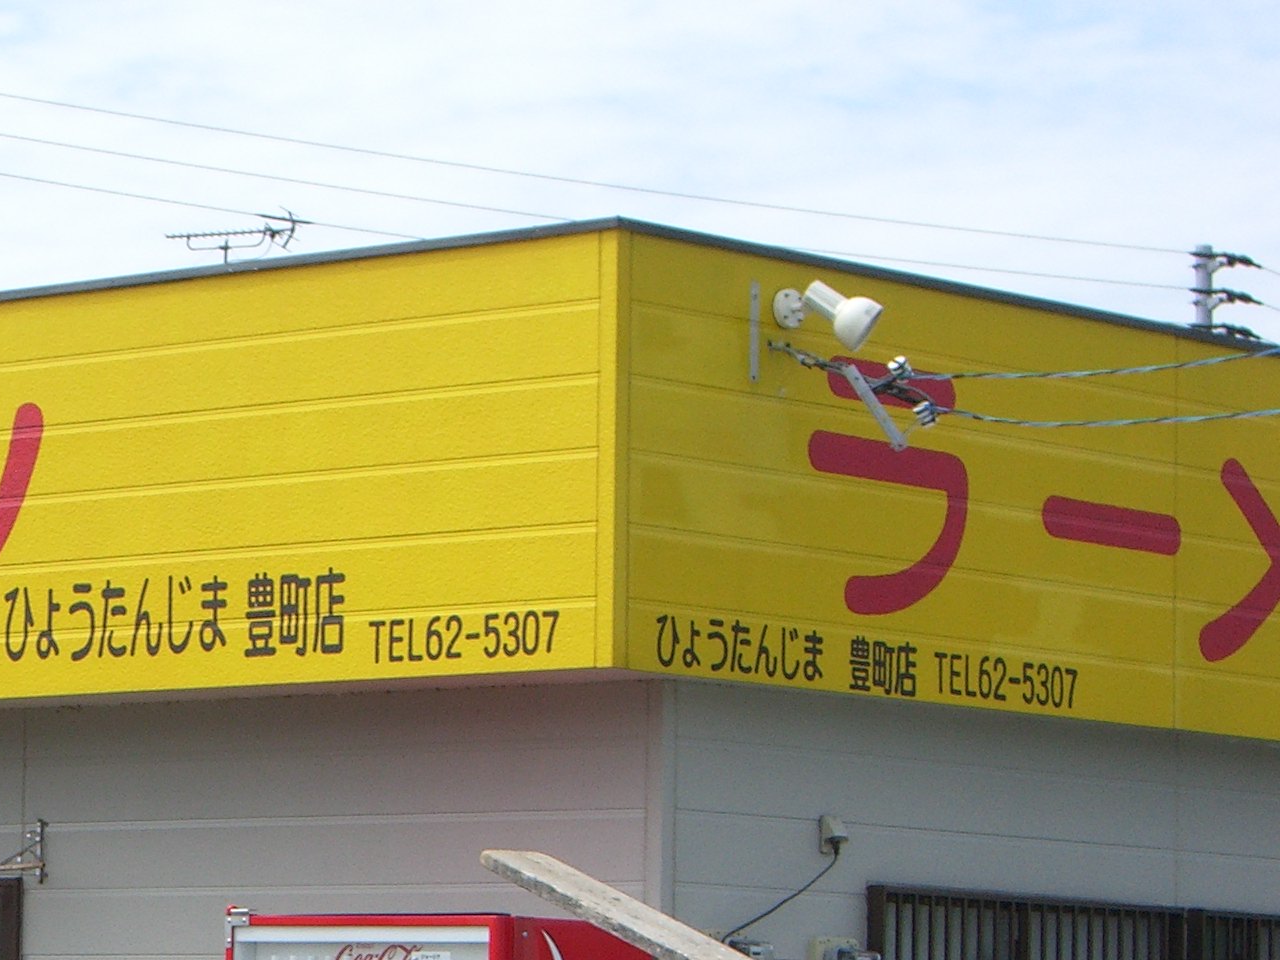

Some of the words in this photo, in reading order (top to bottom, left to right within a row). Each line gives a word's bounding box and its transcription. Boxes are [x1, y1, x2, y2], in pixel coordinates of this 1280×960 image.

[5, 575, 227, 662] ひょうたんじま
[244, 567, 345, 657] 豊町店
[656, 613, 824, 681] ひょうたんじま
[849, 635, 918, 697] 豊町店
